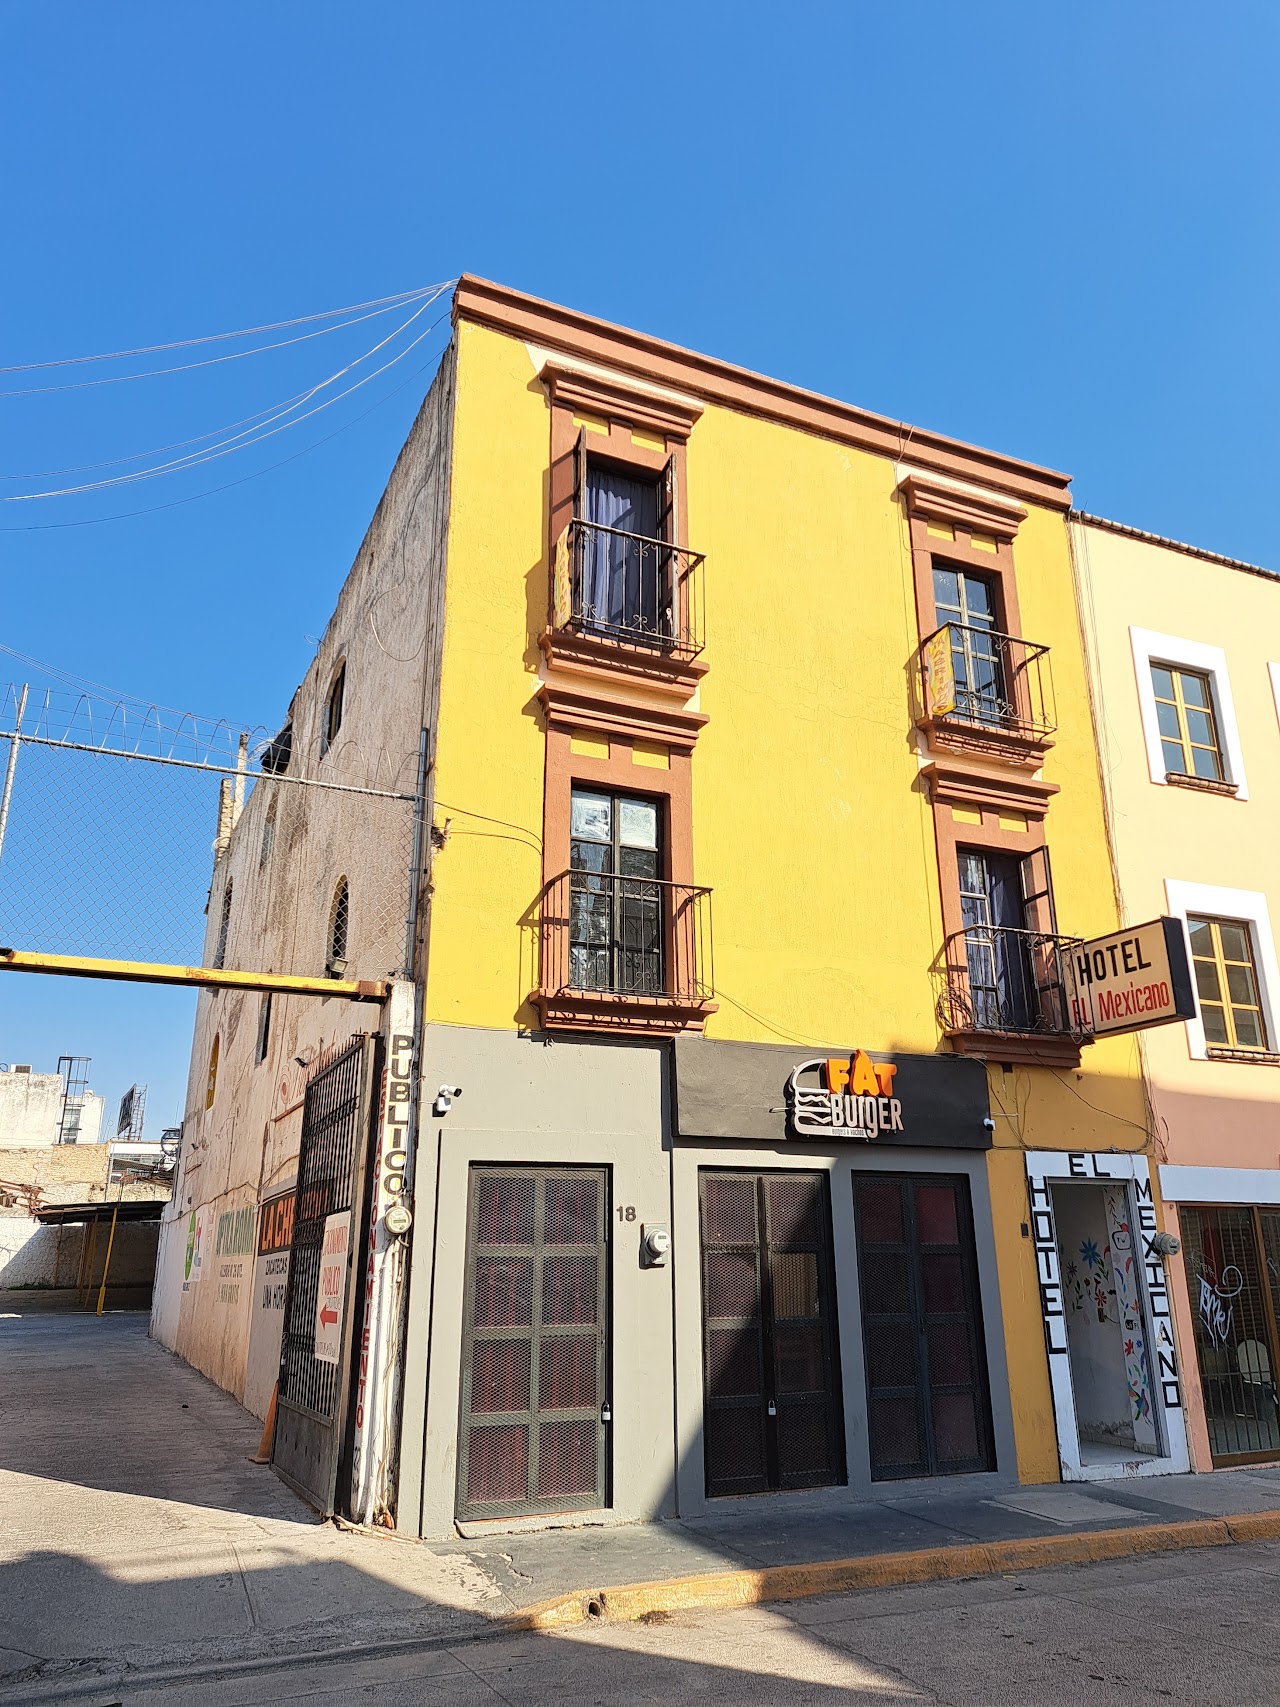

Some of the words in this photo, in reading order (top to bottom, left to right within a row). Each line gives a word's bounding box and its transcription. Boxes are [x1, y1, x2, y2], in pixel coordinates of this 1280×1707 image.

[1077, 937, 1152, 986] HOTEL
[1097, 981, 1170, 1022] Mexicano
[827, 1048, 896, 1095] FAT
[384, 1034, 415, 1196] PUBLICO
[1067, 1153, 1111, 1178] EL
[261, 1204, 274, 1250] LA
[616, 1206, 637, 1222] 18
[355, 1068, 388, 1429] ESTACIONAMIENTO
[1116, 1236, 1128, 1244] TV
[1029, 1176, 1067, 1355] HOTEL
[1134, 1178, 1182, 1409] MEXICANO
